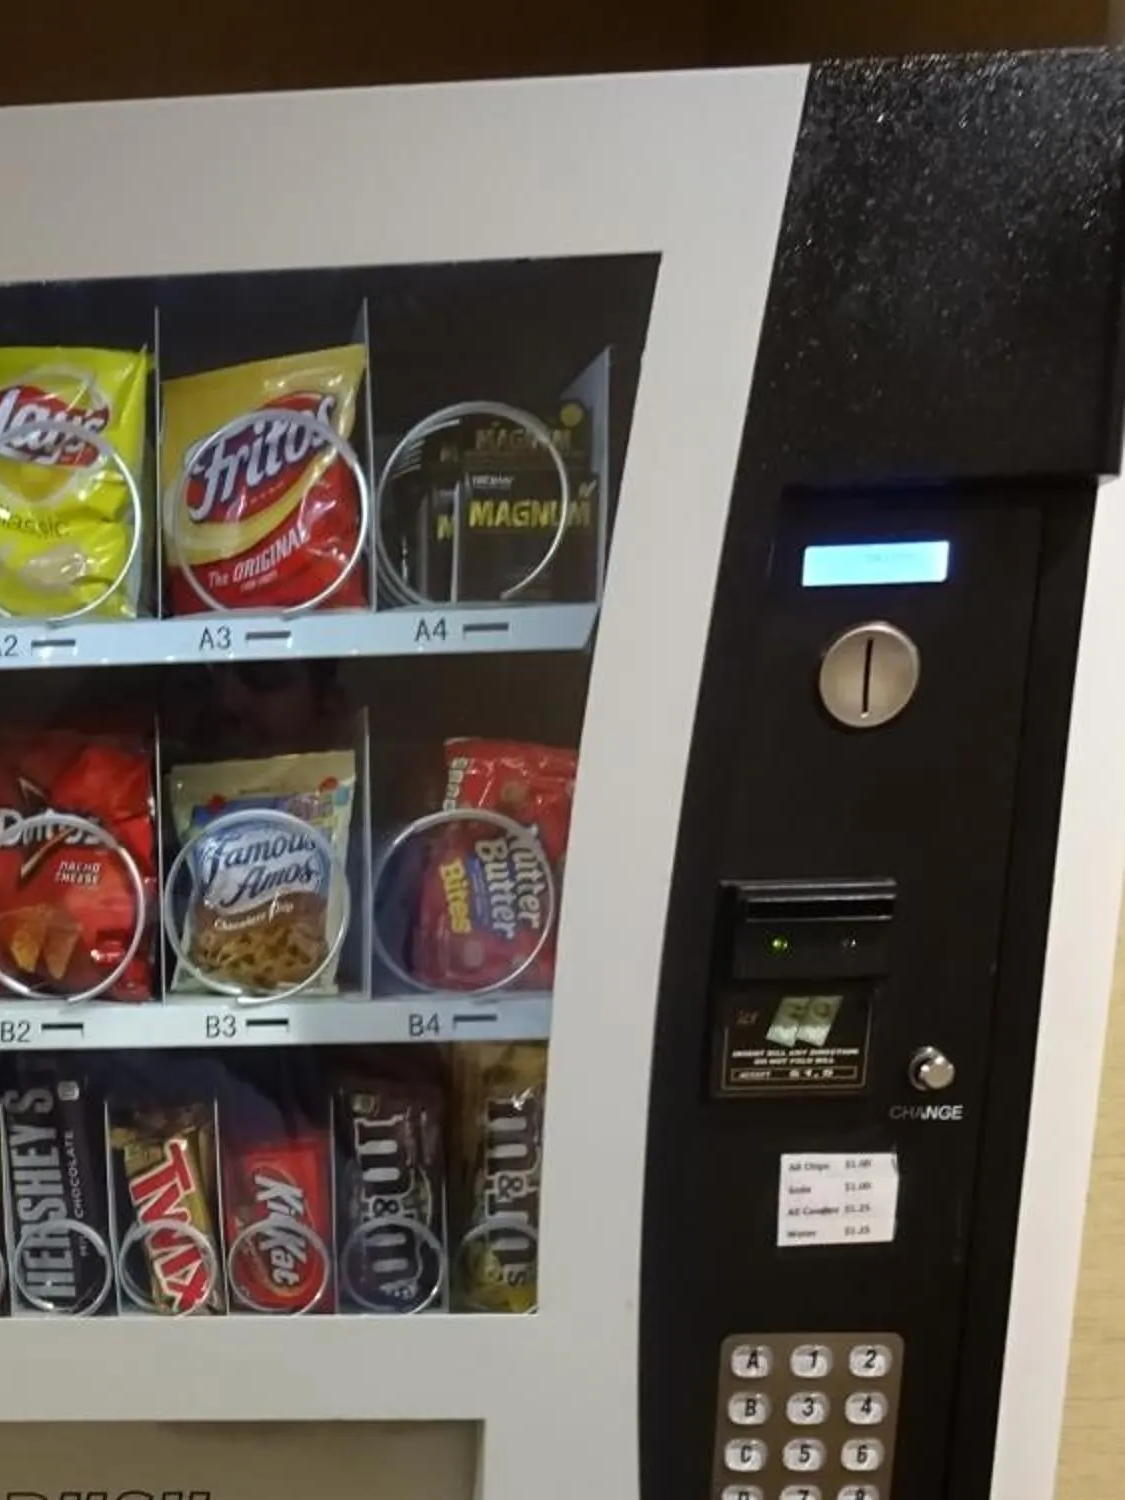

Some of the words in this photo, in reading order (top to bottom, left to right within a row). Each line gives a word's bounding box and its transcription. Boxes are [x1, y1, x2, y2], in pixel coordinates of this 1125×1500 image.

[475, 428, 573, 452] MAGM
[186, 396, 335, 521] Fritos
[198, 627, 231, 649] A3
[414, 617, 447, 641] A4
[220, 860, 320, 908] Amos
[475, 837, 514, 940] Butter
[438, 860, 472, 934] Bites
[0, 1020, 30, 1043] B2
[205, 1015, 237, 1038] B3
[408, 1012, 441, 1037] B4
[888, 1104, 964, 1120] CHANGE
[129, 1138, 209, 1312] TWIX
[746, 1350, 759, 1369] A
[809, 1350, 819, 1369] 1
[864, 1350, 877, 1369] 2
[744, 1398, 756, 1417] B
[802, 1397, 814, 1417] 3
[860, 1396, 872, 1415] 4
[740, 1445, 753, 1463] C
[799, 1444, 811, 1463] 5
[856, 1445, 868, 1464] 6
